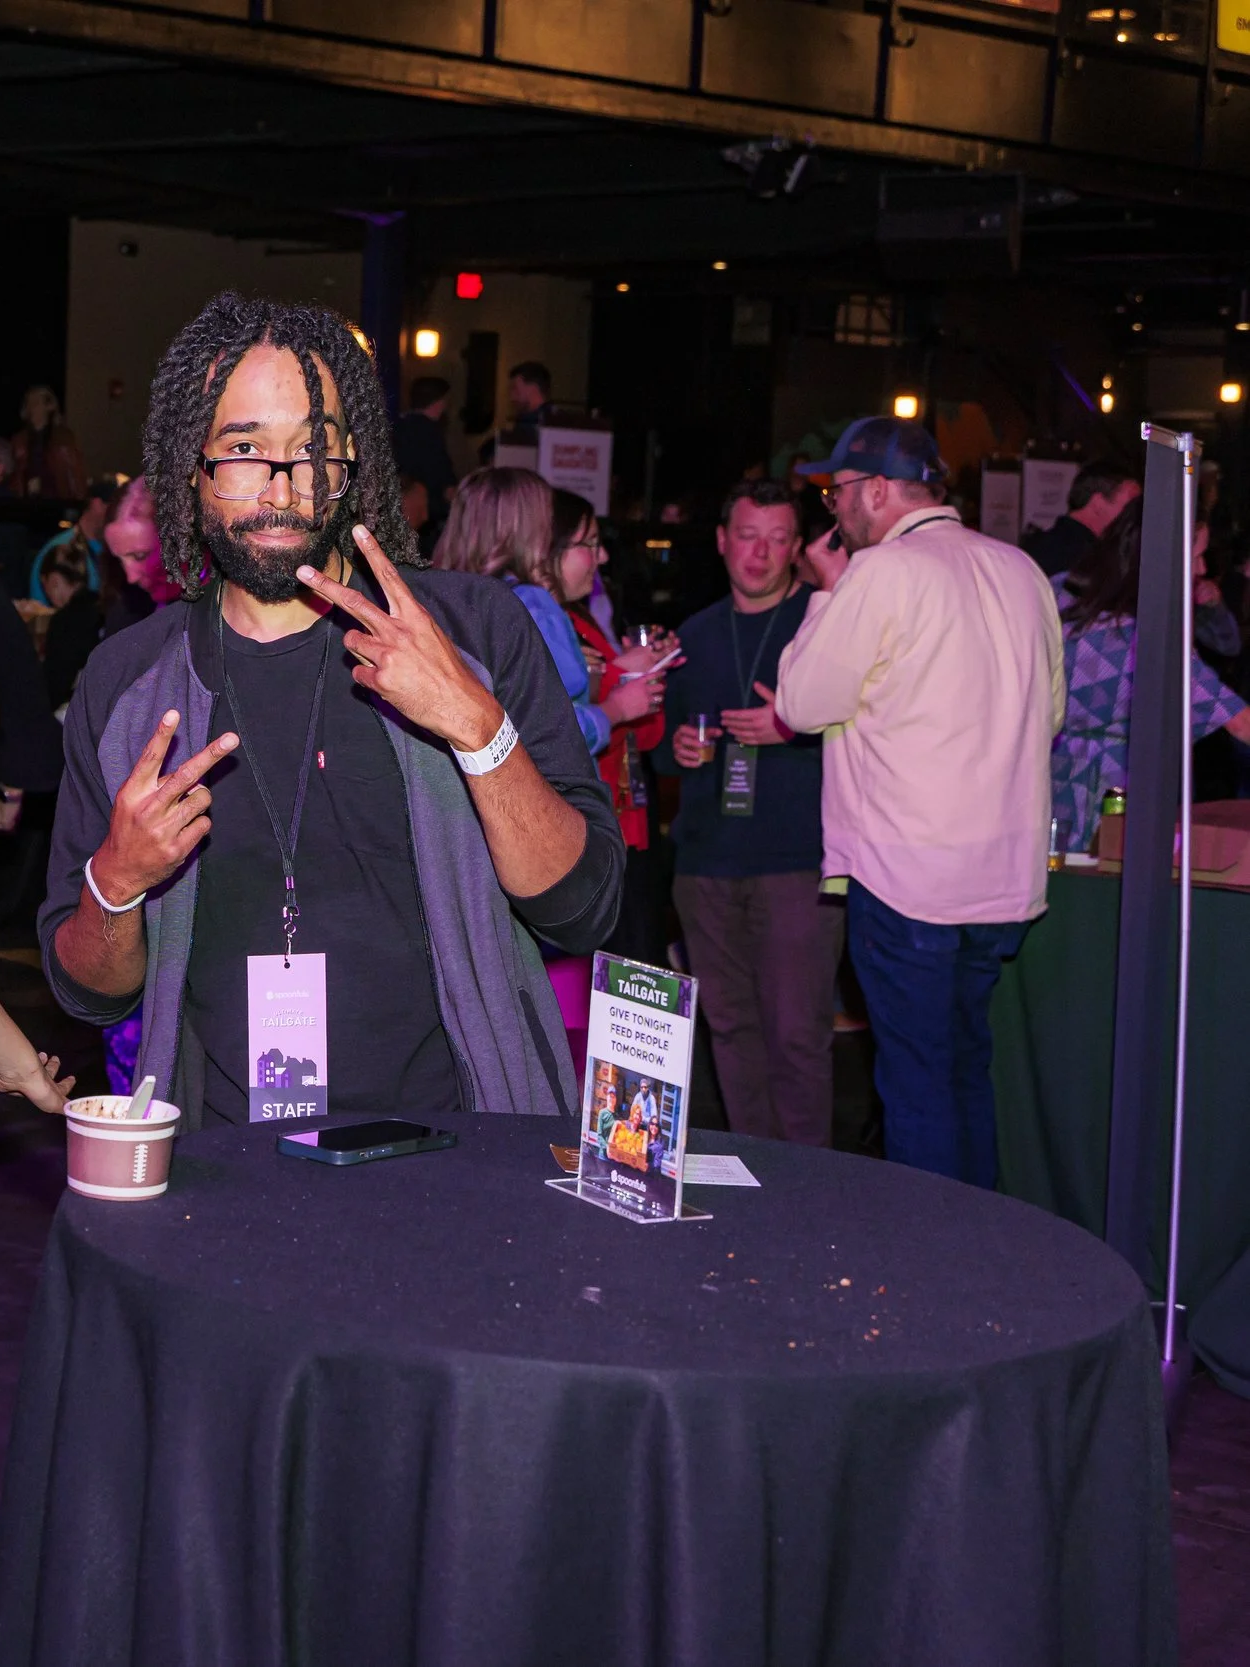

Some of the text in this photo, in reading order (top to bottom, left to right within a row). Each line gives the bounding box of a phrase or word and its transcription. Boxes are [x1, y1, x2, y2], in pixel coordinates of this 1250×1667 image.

[617, 978, 669, 1007] TAILGATE
[629, 973, 658, 988] ULTIMATE
[261, 1016, 317, 1028] TAILGATE
[609, 1006, 673, 1036] GIVE TONIGHT.
[610, 1023, 670, 1051] FEED PEOPLE
[610, 1039, 666, 1068] TOMORROW.
[261, 1102, 317, 1119] STAFF
